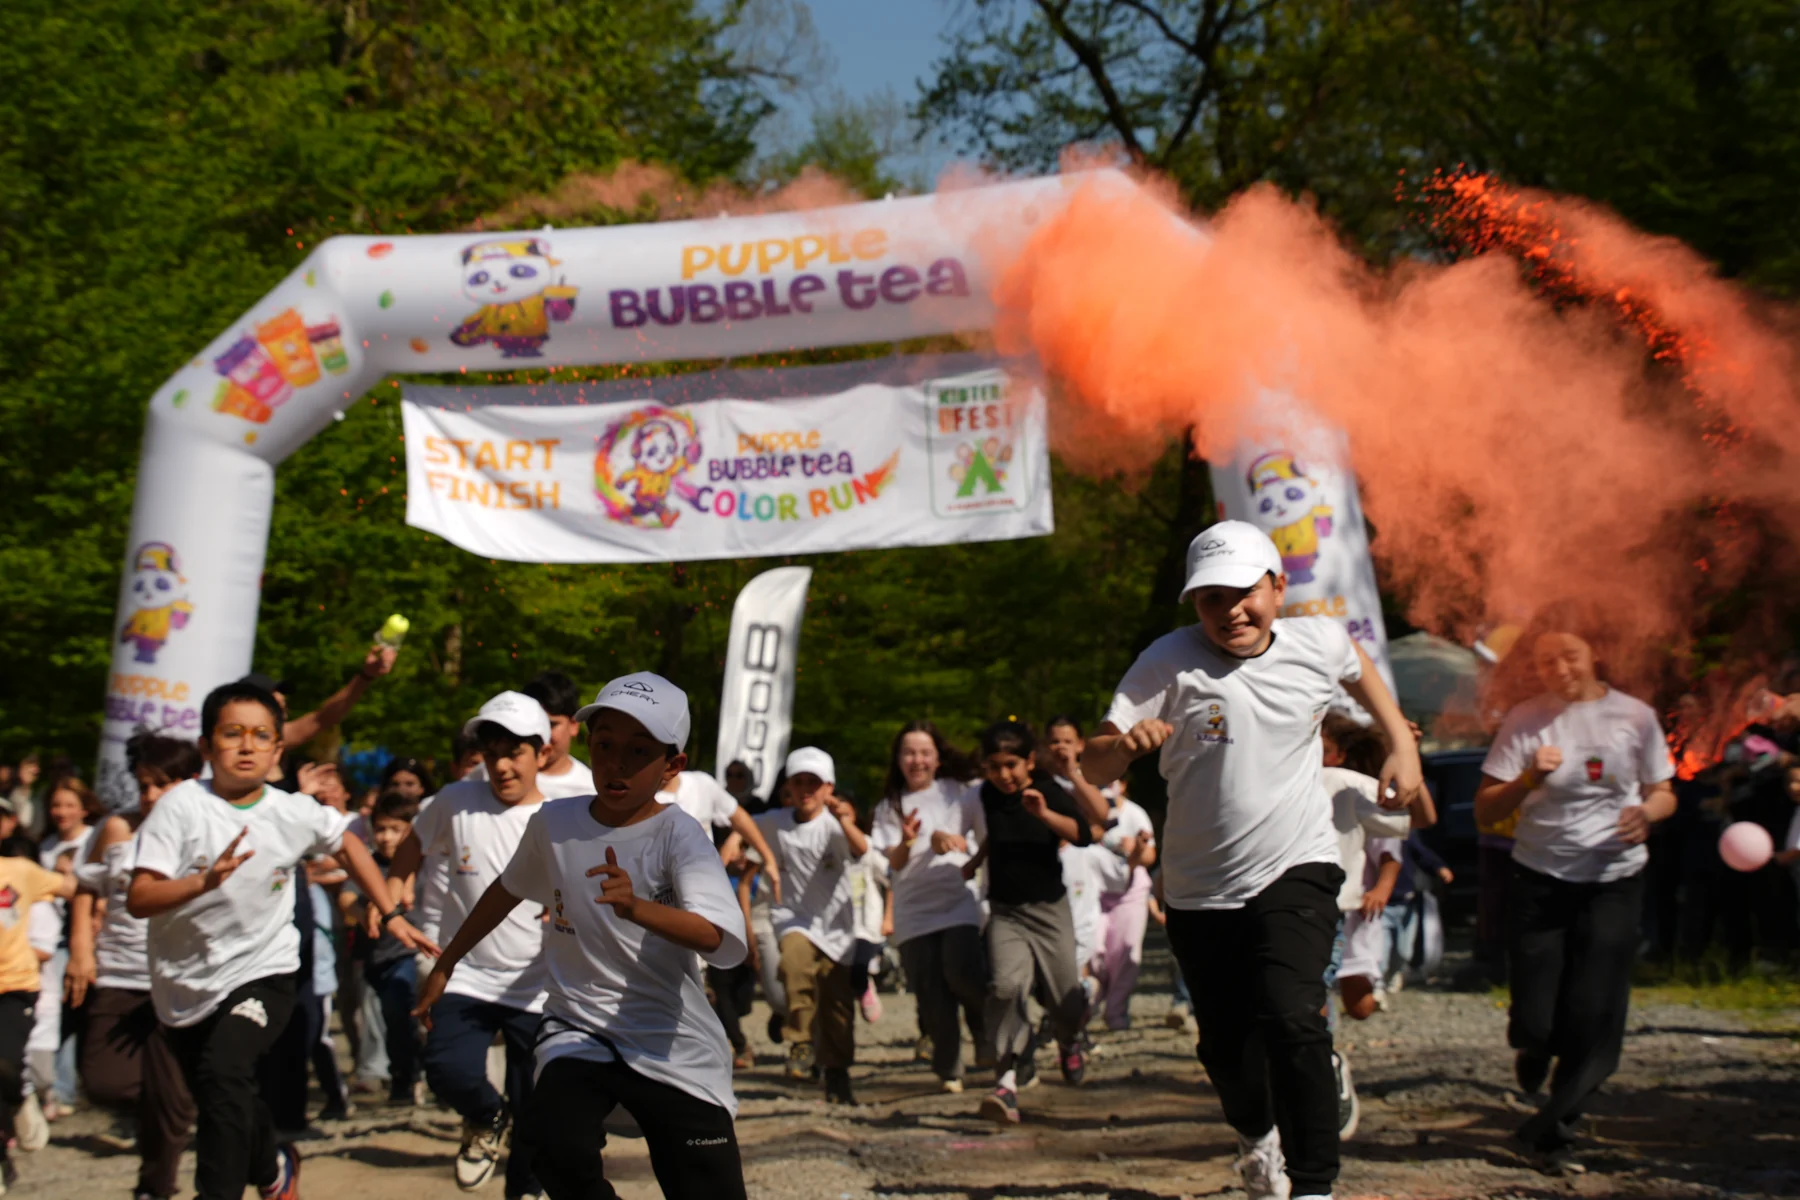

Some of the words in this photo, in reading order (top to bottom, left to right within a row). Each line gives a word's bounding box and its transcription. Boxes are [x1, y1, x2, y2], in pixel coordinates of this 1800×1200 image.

[837, 257, 971, 311] tea
[425, 436, 560, 471] START
[800, 451, 854, 478] tea
[427, 472, 560, 510] FINISH
[695, 485, 800, 522] COLOR
[808, 466, 886, 519] RUN
[610, 690, 660, 705] CHERY
[694, 1136, 728, 1146] Columbia
